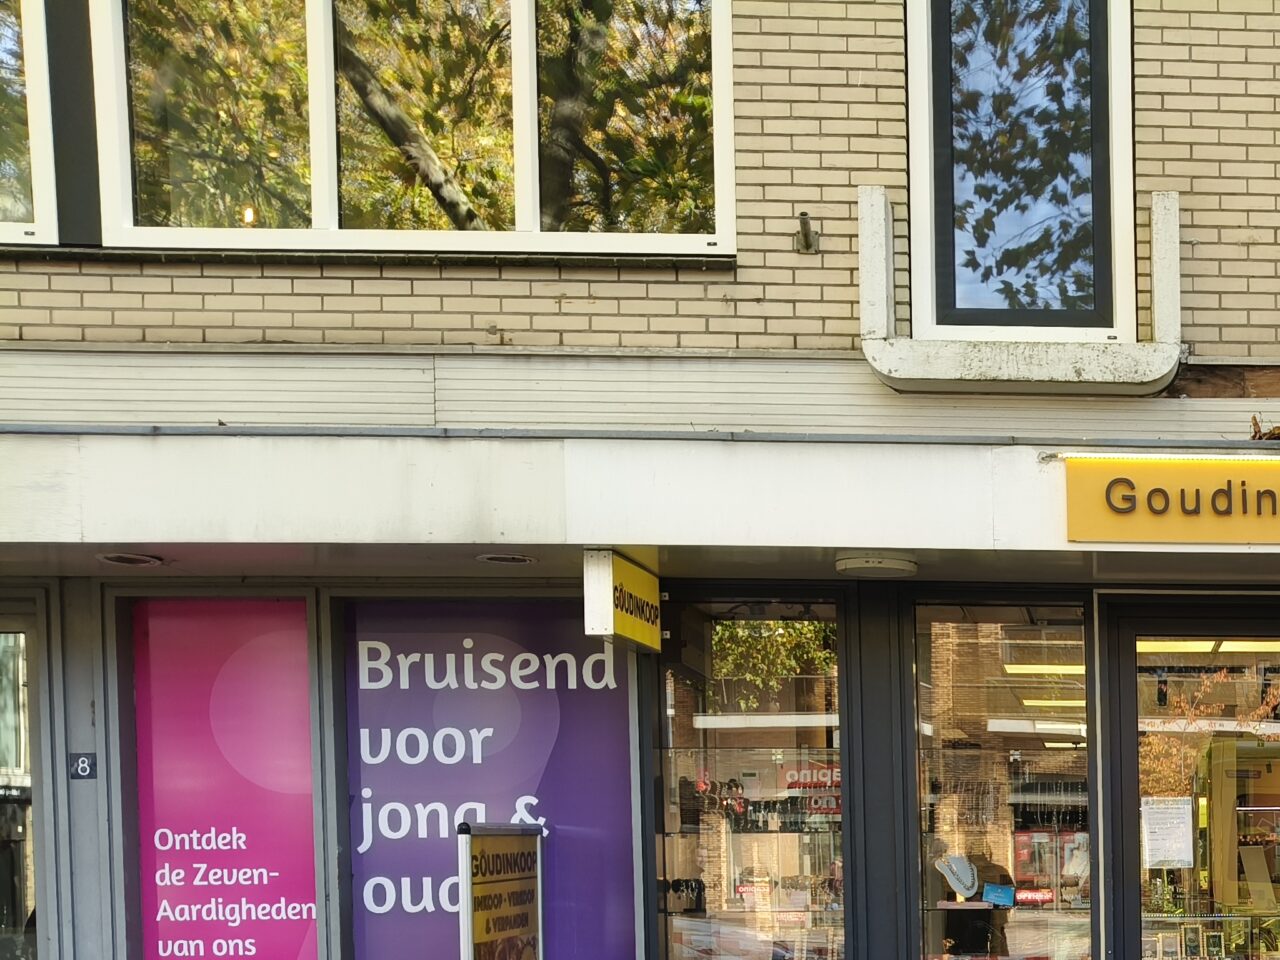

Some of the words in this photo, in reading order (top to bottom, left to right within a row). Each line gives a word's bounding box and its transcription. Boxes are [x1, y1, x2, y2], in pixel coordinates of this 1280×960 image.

[613, 583, 659, 628] GOUDINKOOP
[358, 637, 618, 690] Bruisend
[359, 727, 494, 765] voor
[77, 756, 91, 776] 8
[510, 795, 550, 838] &
[153, 826, 248, 851] Ontdek
[155, 862, 186, 887] de
[192, 863, 280, 886] Zeven-
[472, 850, 538, 878] GOUDINKOOP
[156, 897, 317, 928] Aardigheden
[158, 938, 205, 957] van
[212, 937, 257, 957] ons
